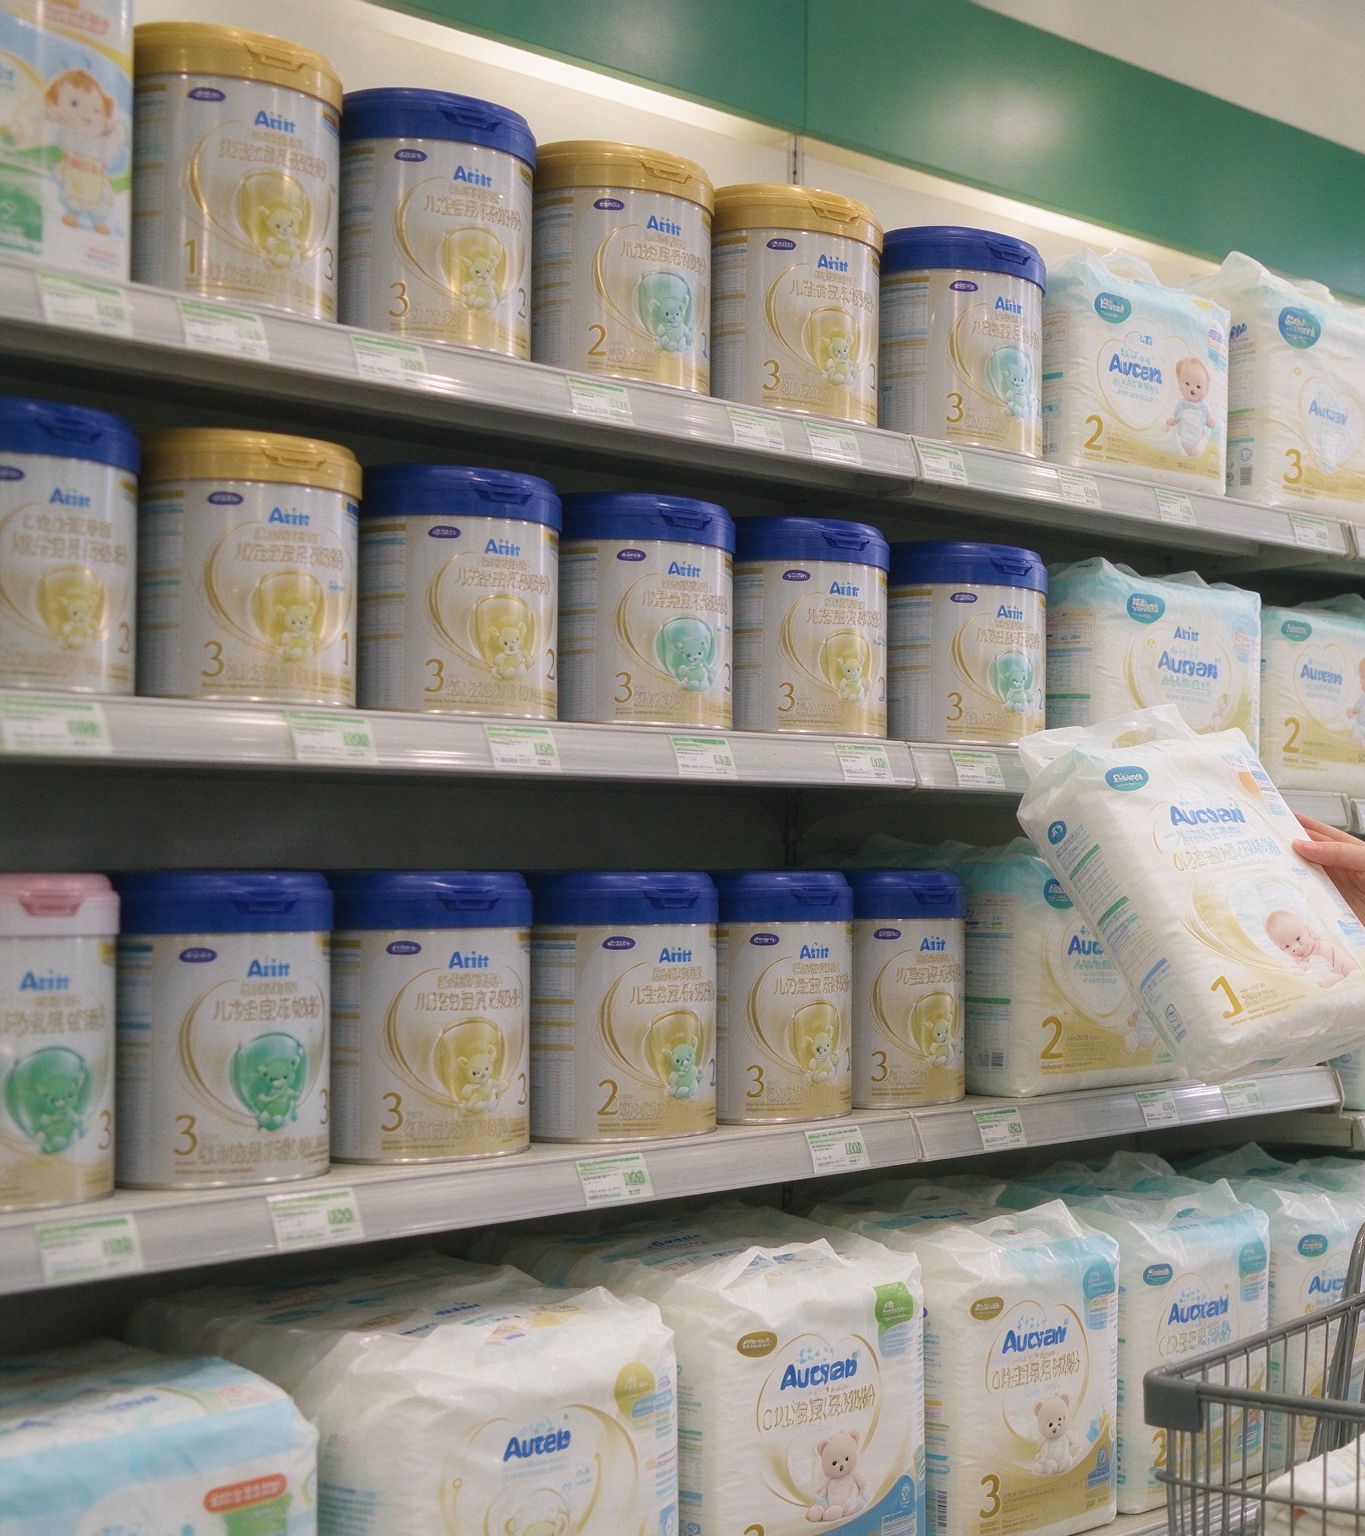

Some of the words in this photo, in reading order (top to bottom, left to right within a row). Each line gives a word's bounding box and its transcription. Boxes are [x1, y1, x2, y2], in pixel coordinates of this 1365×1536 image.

[184, 239, 198, 275] 1
[388, 282, 410, 319] 3
[587, 324, 607, 356] 2
[763, 360, 780, 391] 3
[946, 392, 964, 423] 3
[1084, 414, 1105, 451] 2
[1283, 448, 1304, 485] 3
[202, 640, 224, 678] 3
[425, 658, 446, 692] 3
[614, 672, 633, 704] 3
[778, 681, 797, 712] 3
[946, 691, 963, 721] 3
[1281, 718, 1301, 753] 2
[1211, 976, 1244, 1019] 1
[1041, 1015, 1064, 1060] 2
[746, 1064, 765, 1098] 3
[870, 1050, 889, 1083] 3
[380, 1092, 403, 1132] 3
[597, 1078, 619, 1116] 2
[174, 1113, 197, 1156] 3
[979, 1474, 1001, 1519] 3
